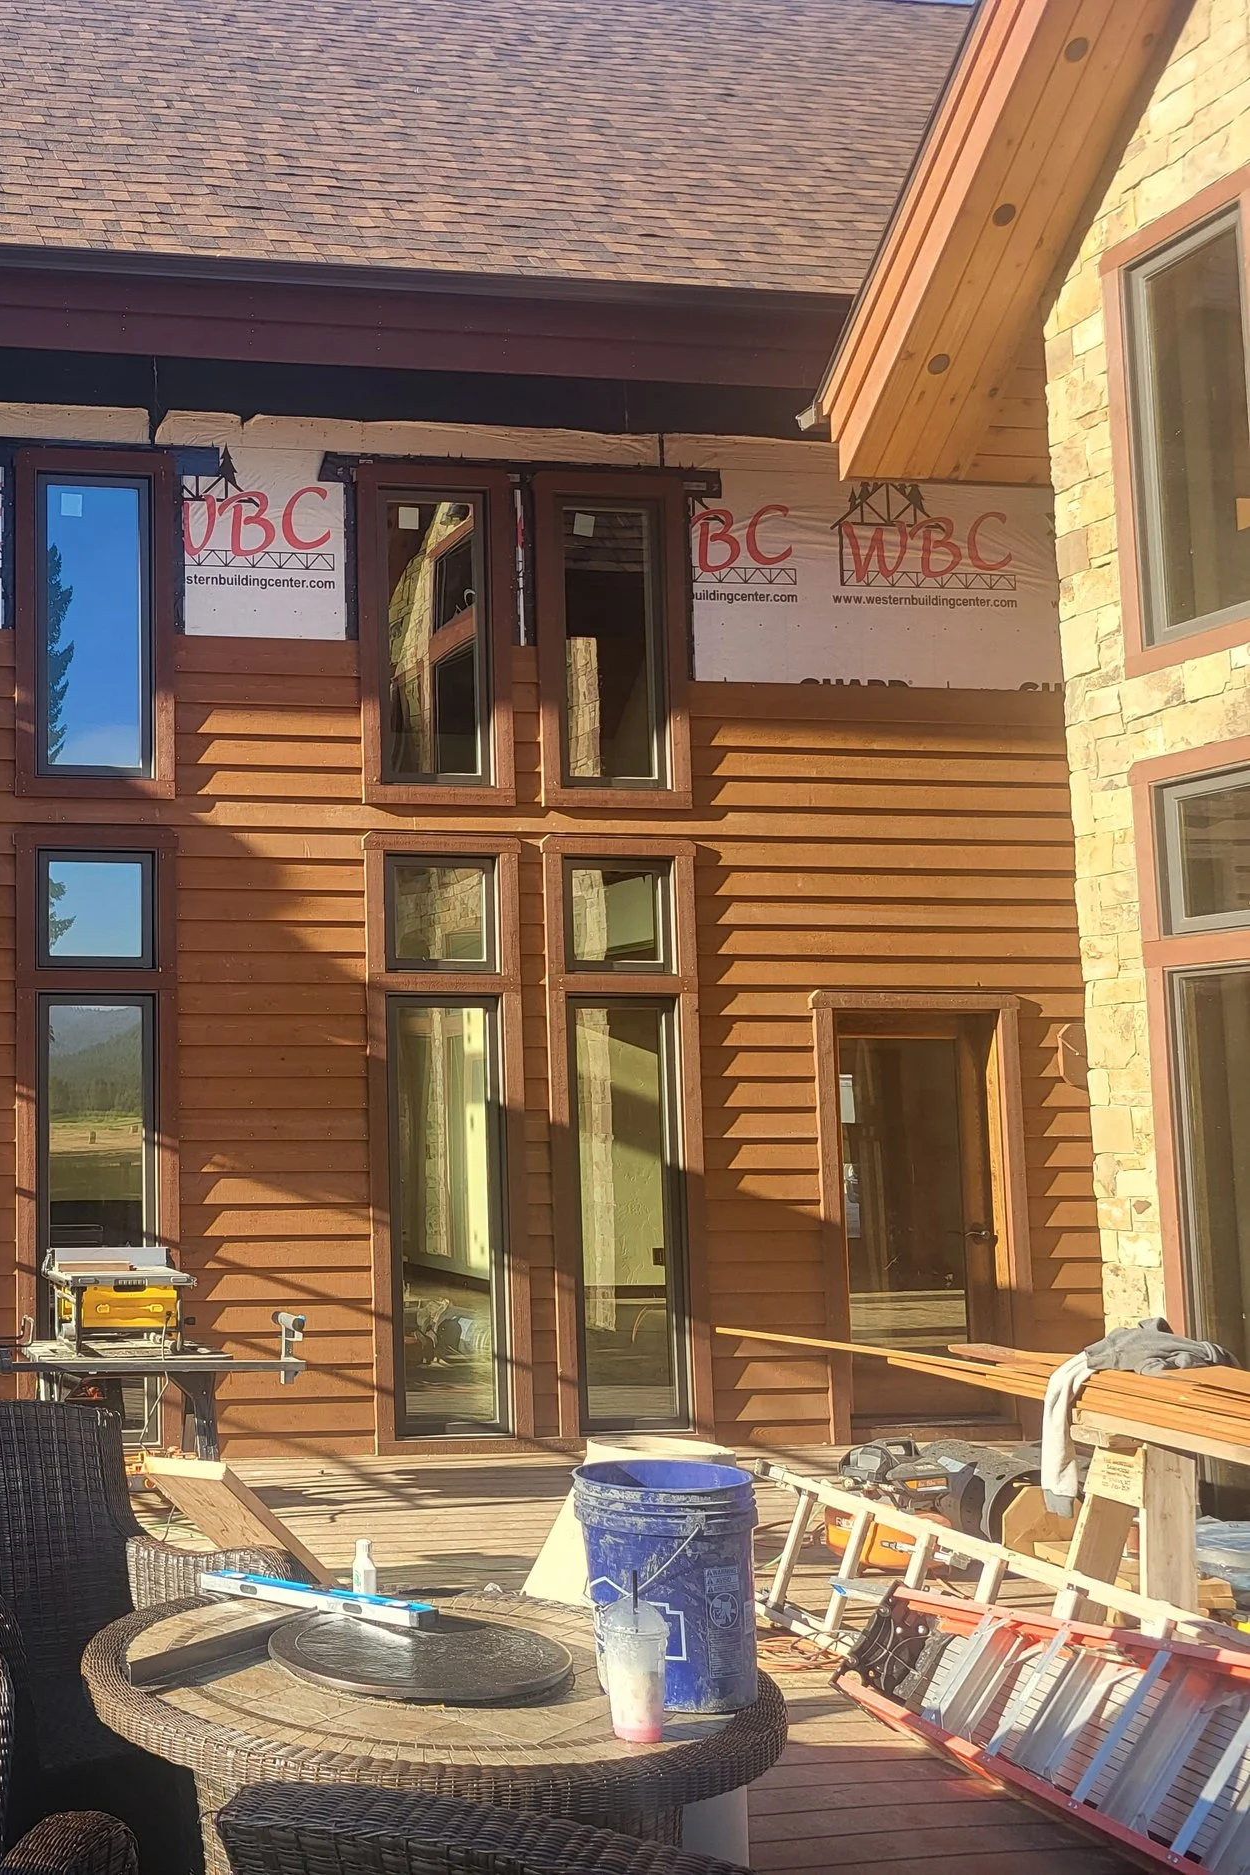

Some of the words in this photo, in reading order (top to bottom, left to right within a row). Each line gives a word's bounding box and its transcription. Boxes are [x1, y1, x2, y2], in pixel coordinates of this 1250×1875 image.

[841, 511, 1012, 583] WBC
[186, 574, 336, 589] sternbuildingcenter.com
[832, 593, 1018, 609] www.westernbuildingcenter.com
